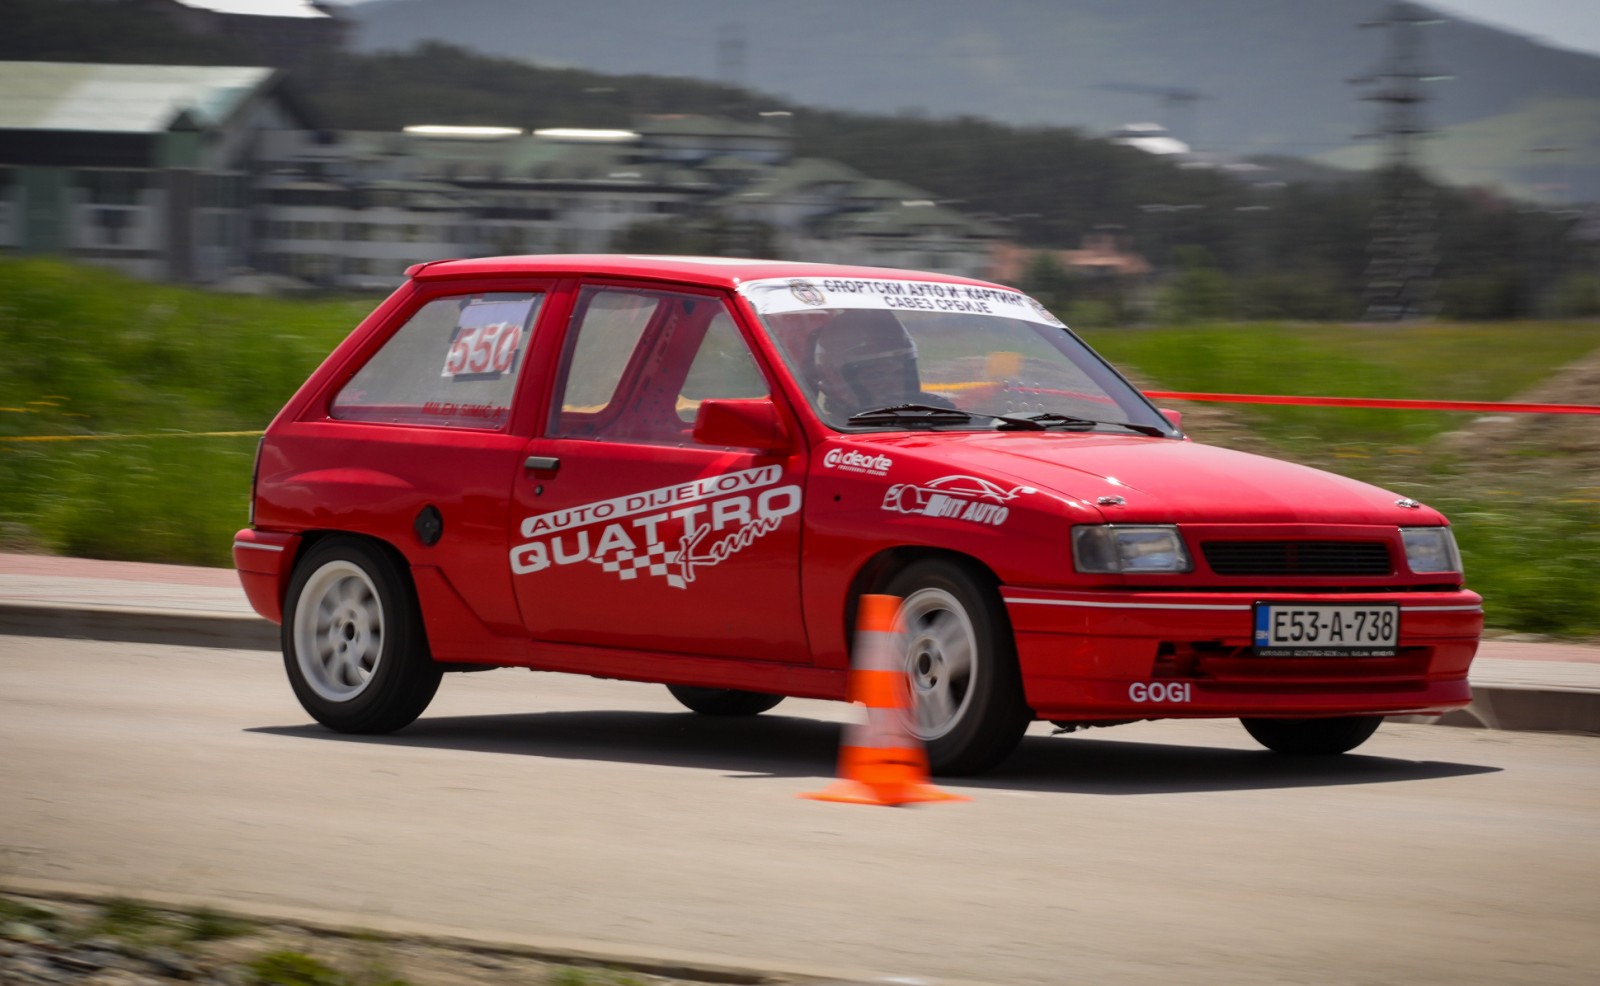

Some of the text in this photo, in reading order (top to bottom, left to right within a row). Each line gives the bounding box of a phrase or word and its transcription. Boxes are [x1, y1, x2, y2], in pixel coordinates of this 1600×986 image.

[824, 280, 904, 295] СПОРТСКИ
[908, 284, 946, 298] АУТО
[948, 285, 960, 298] И
[884, 295, 993, 314] САВЕЗ СРБИЈЕ
[447, 326, 519, 373] 550
[529, 467, 774, 534] AUTO DIJELOVI
[960, 501, 1010, 525] AUTO
[509, 484, 802, 575] QUATTRO
[1273, 611, 1394, 643] E53-A-738
[1128, 682, 1191, 702] GOGI
